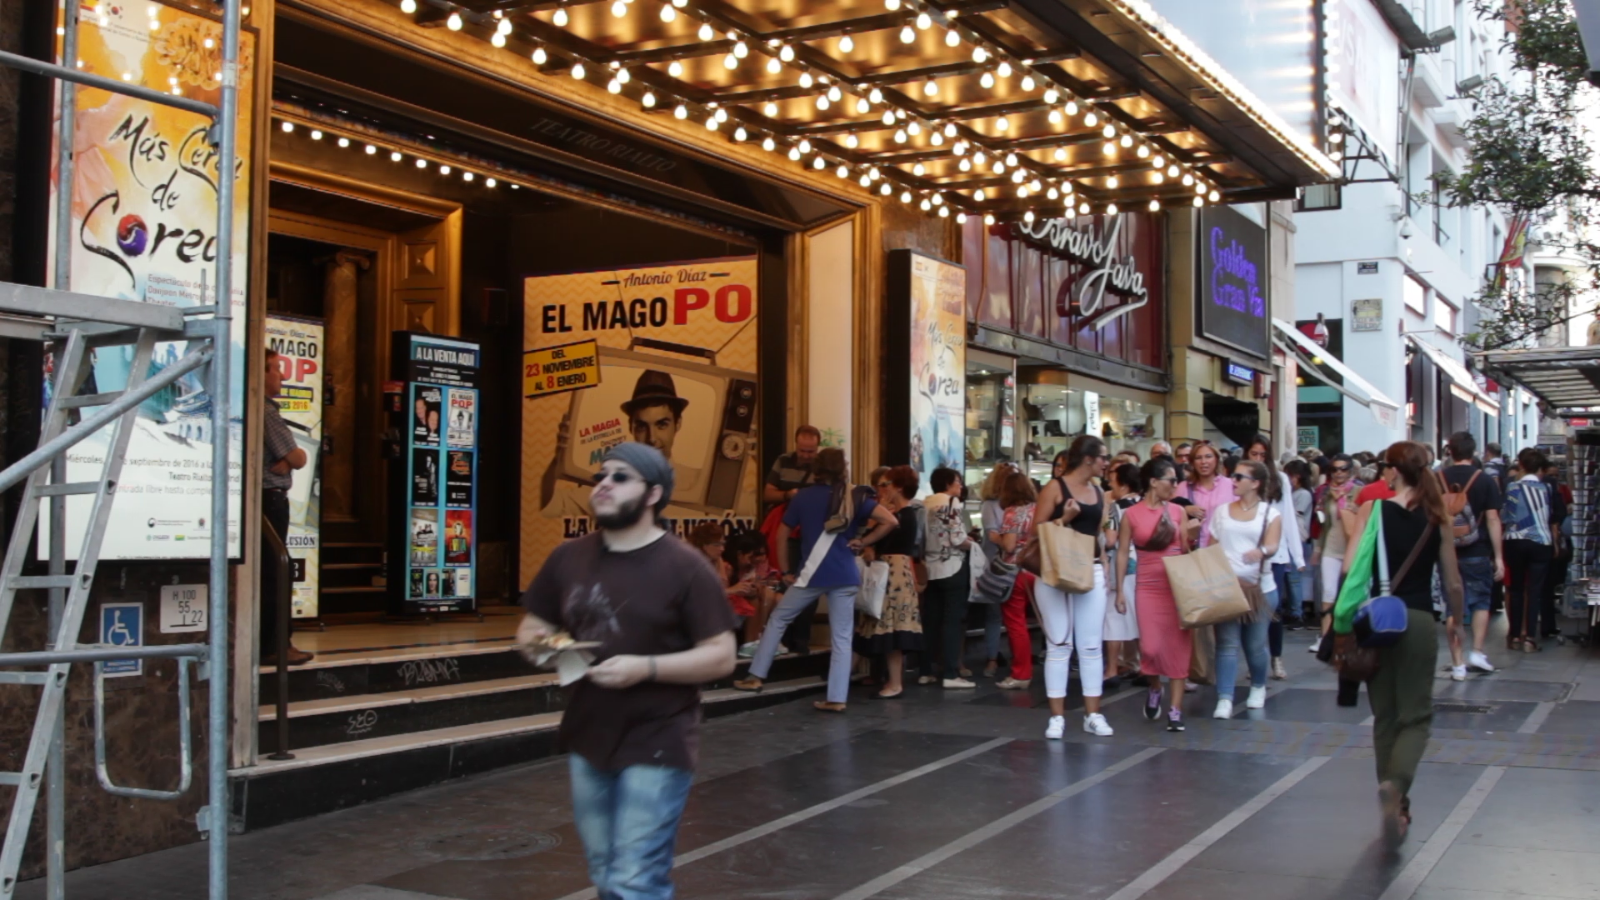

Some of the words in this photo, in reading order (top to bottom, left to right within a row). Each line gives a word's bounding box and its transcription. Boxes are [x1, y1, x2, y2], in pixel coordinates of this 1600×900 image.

[109, 114, 169, 189] Más
[530, 117, 610, 149] TEATRO
[609, 144, 676, 172] RIALTO
[151, 169, 182, 211] de
[1211, 226, 1257, 284] Golden
[623, 271, 673, 288] Antonio
[677, 268, 707, 283] Díaz
[542, 305, 572, 333] EL
[583, 297, 667, 331] MAGO
[270, 337, 318, 358] MAGO
[416, 347, 422, 359] A
[423, 347, 433, 360] LA
[434, 349, 457, 364] VENTA
[552, 349, 566, 359] DEL
[526, 363, 540, 377] 23
[542, 356, 595, 374] NOVIEMBRE
[534, 382, 544, 391] AL
[547, 375, 554, 389] 8
[557, 372, 586, 387] ENERO
[579, 427, 590, 438] LA
[592, 418, 621, 433] MAGIA
[130, 458, 170, 469] septiembre
[173, 459, 182, 468] de
[183, 460, 199, 469] 2016
[169, 471, 191, 482] Teatro
[146, 484, 163, 495] libre
[563, 518, 588, 538] LA
[172, 591, 178, 600] H
[182, 590, 196, 600] 100
[178, 601, 190, 613] 55
[191, 610, 203, 623] 22
